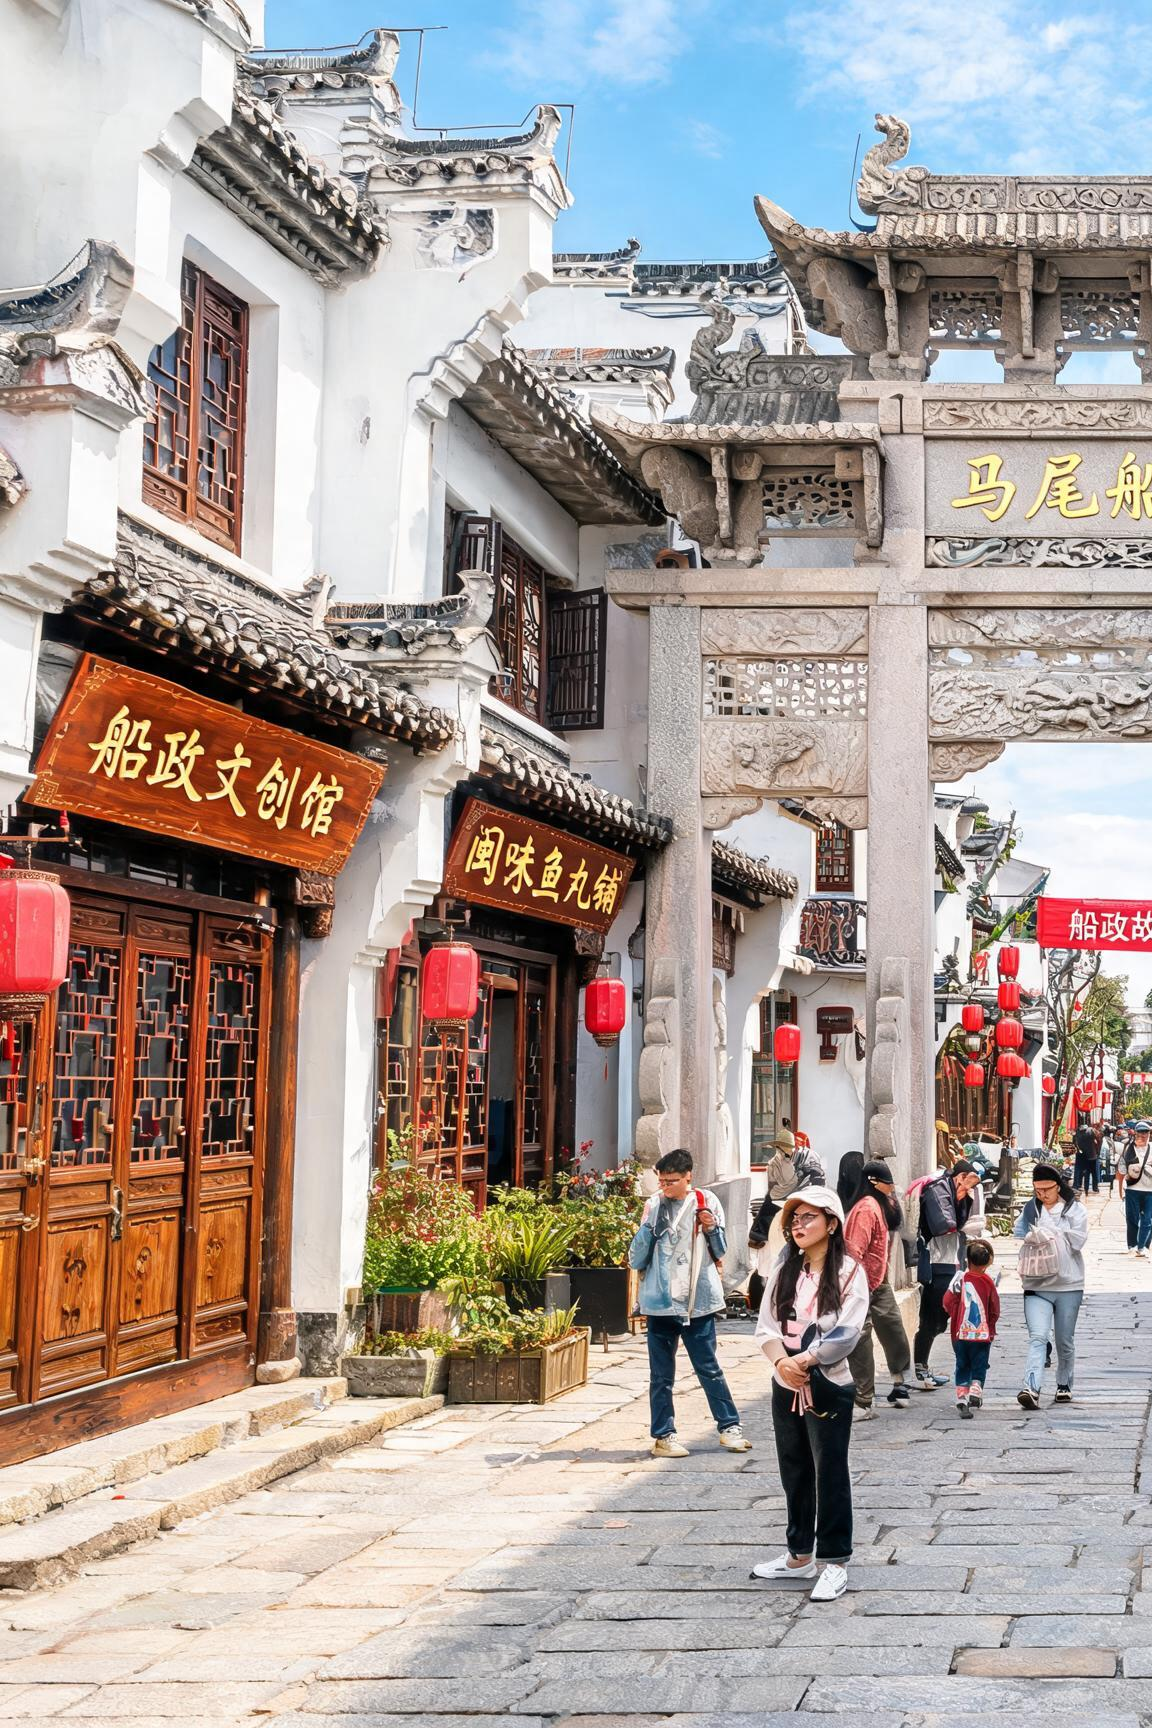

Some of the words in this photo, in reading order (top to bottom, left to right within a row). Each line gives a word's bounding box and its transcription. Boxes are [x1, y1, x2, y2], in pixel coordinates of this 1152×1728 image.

[88, 705, 344, 838] 船政文创馆
[465, 825, 623, 915] 闽味鱼丸铺
